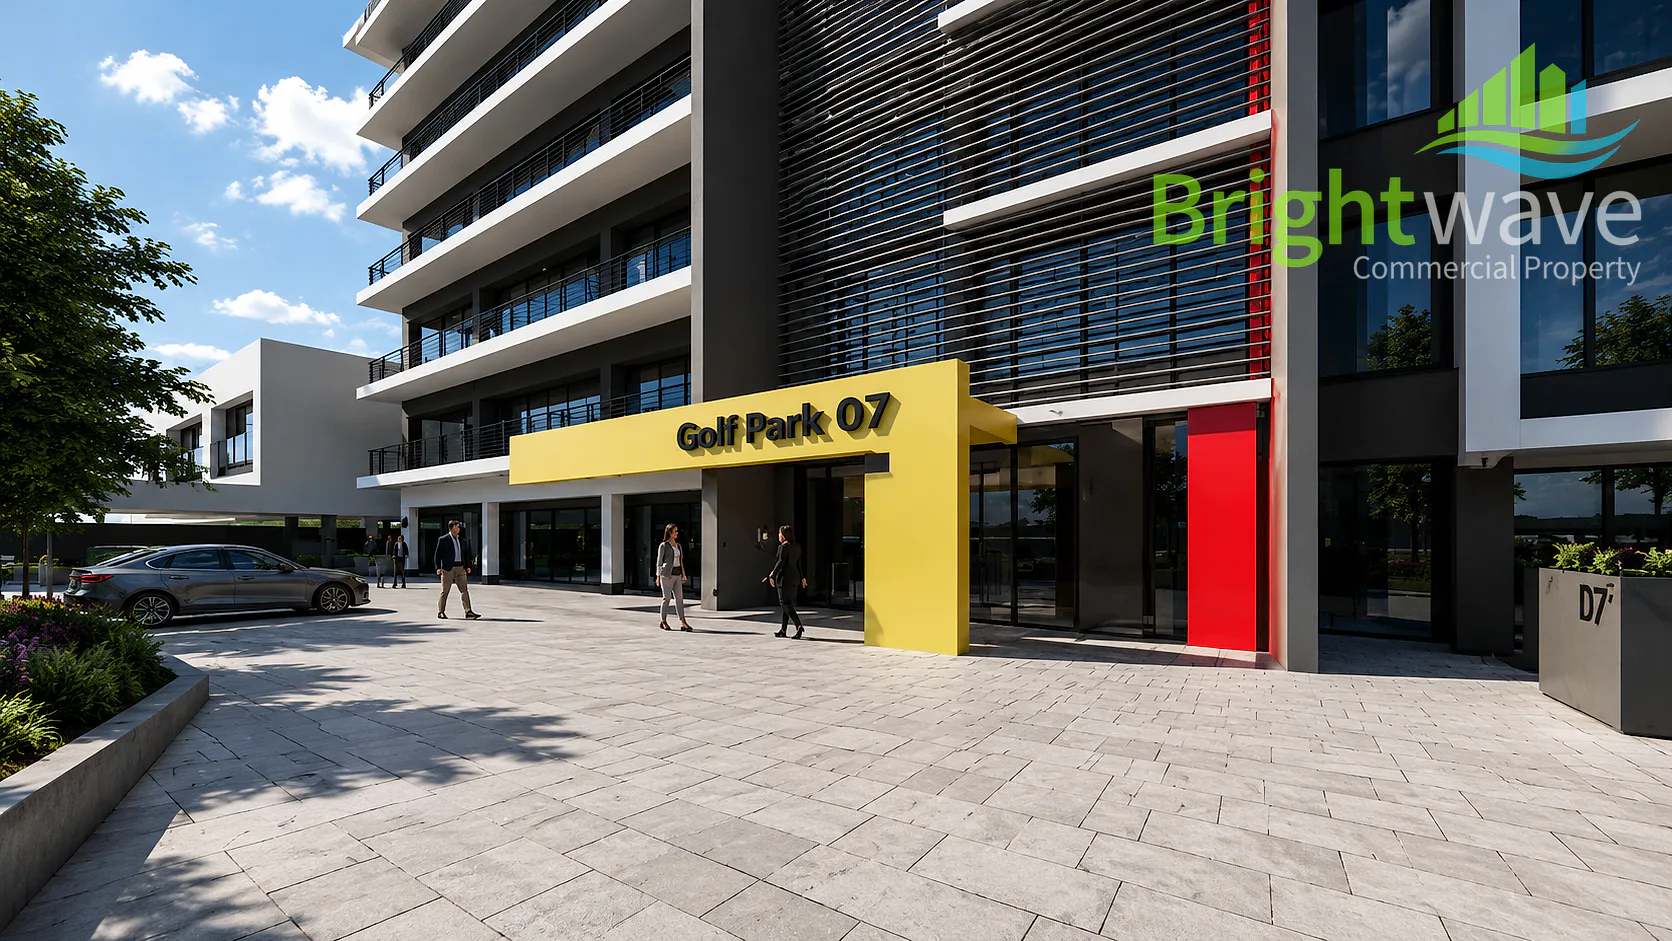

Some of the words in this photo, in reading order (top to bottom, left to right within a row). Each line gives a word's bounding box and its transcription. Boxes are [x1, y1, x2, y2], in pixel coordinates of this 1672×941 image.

[677, 414, 739, 451] Golf
[746, 402, 826, 444] Park
[836, 391, 891, 432] 07
